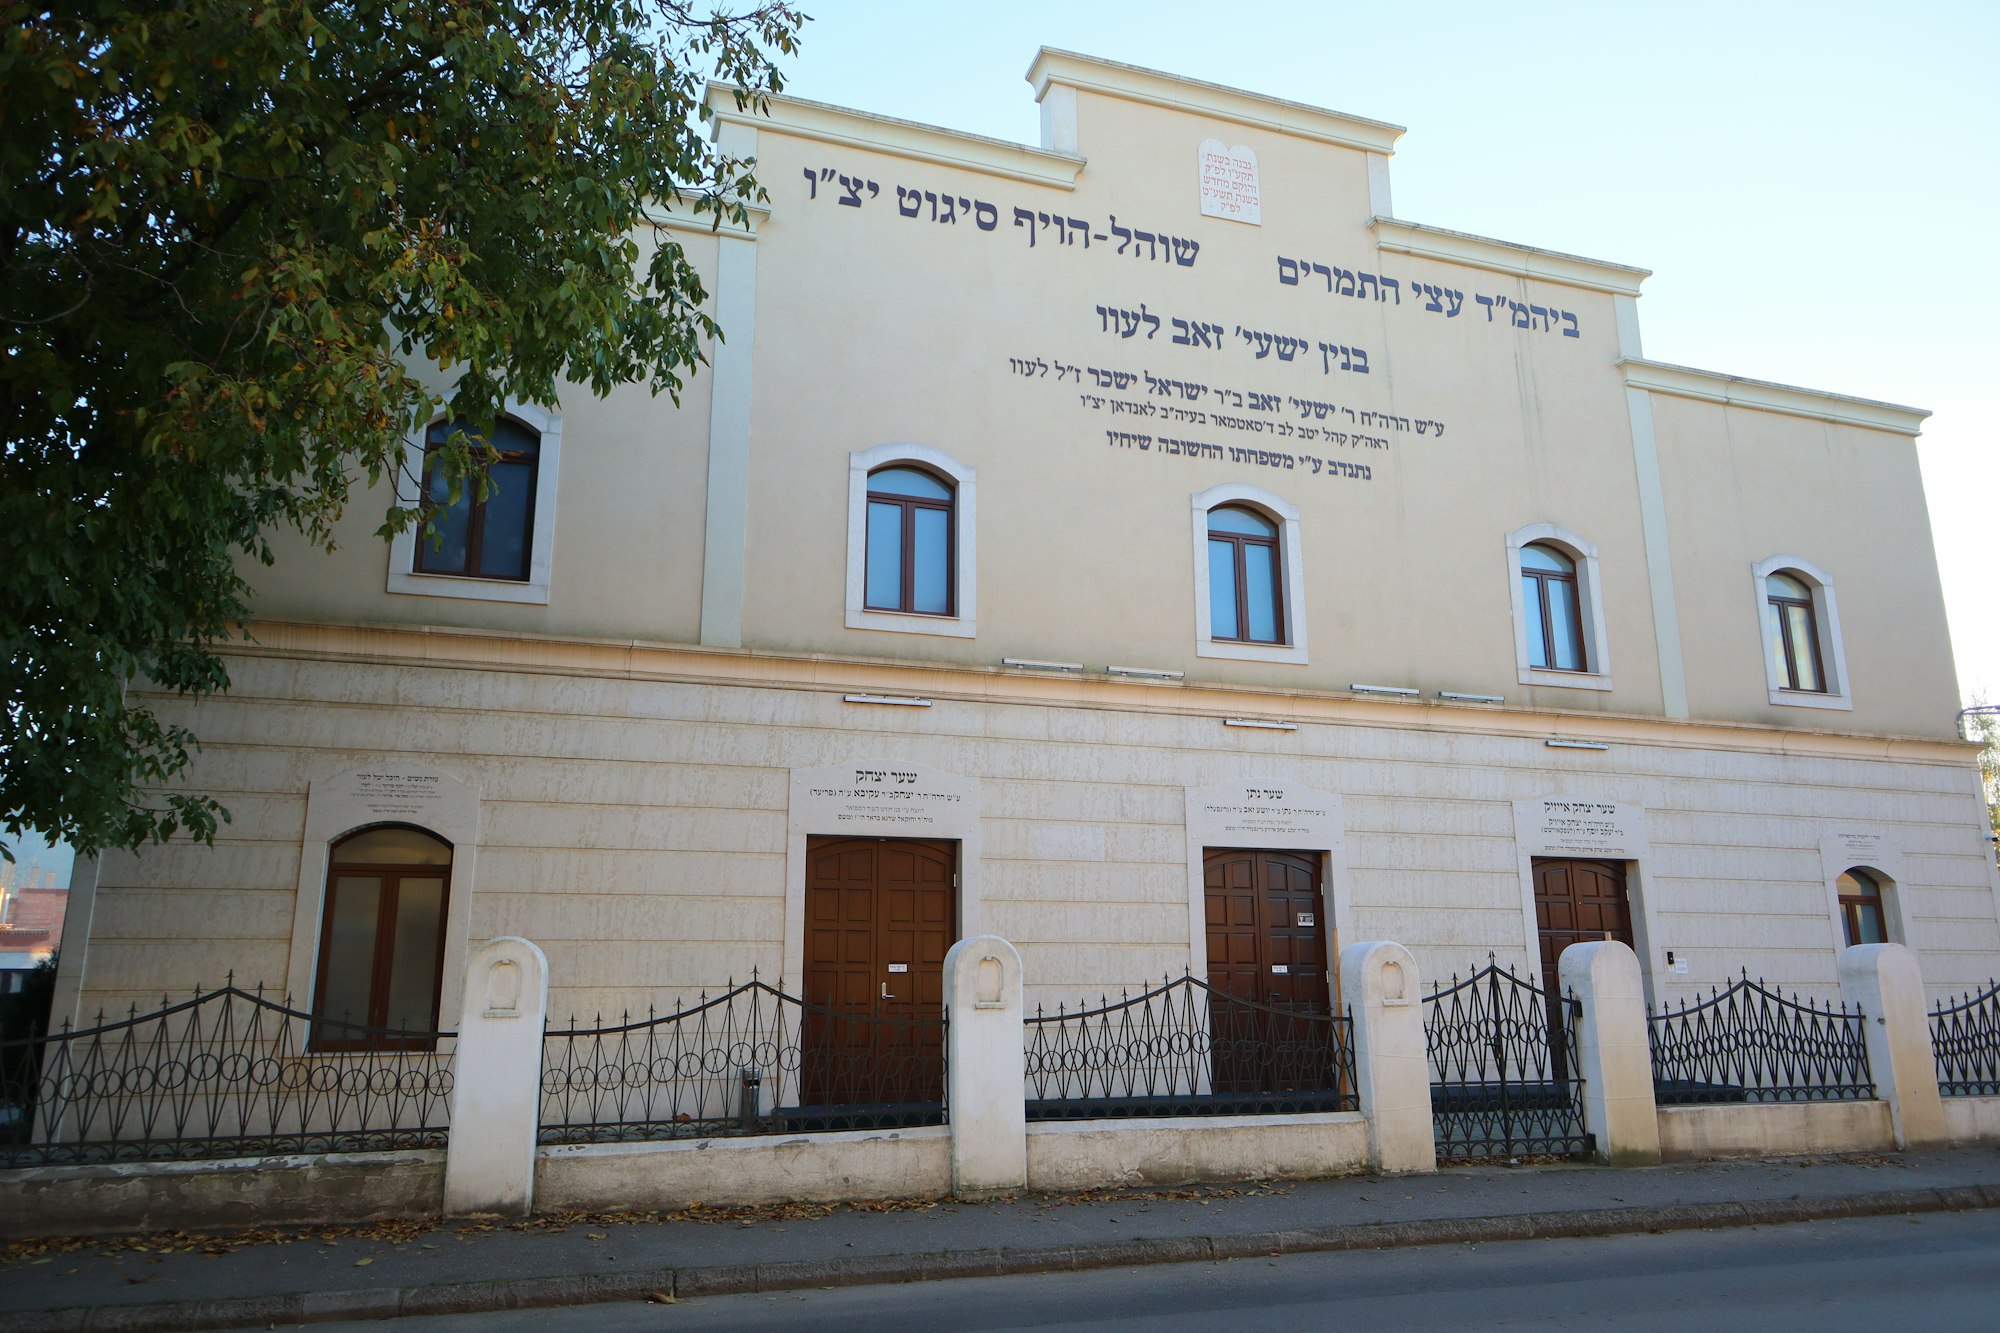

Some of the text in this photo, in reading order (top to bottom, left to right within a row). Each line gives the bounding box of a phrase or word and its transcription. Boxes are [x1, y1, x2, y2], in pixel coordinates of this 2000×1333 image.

[1205, 164, 1226, 175] לפ"ק
[1206, 153, 1252, 170] נבנה בשנת
[804, 167, 879, 208] יצ"ו
[1203, 175, 1257, 193] והוקם מחדש
[897, 185, 998, 231] סיגוט
[1235, 193, 1259, 206] בשנת
[1277, 255, 1579, 338] ביהמ"ד עצי התמרים
[1096, 303, 1369, 375] בנין ישעי' זאב לעוו
[1010, 357, 1048, 378] לעוו
[1054, 360, 1081, 383] ז"ל
[1087, 367, 1137, 390] ישכר
[1144, 370, 1208, 400] ישראל
[1081, 395, 1105, 409] יצ"ו
[1214, 389, 1243, 407] ב"ר
[1248, 392, 1281, 413] זאב
[1110, 400, 1156, 416] לאנדאן
[1288, 396, 1335, 419] ישעי'
[1278, 421, 1293, 436] לב
[1361, 411, 1409, 432] הרה"ח
[1415, 419, 1444, 437] ע"ש
[1298, 427, 1319, 439] יטב
[1322, 427, 1347, 446] קהל
[1107, 430, 1371, 480] נתנדב ע"י משפחתו החשובה שיחיו
[855, 769, 917, 785] שער יצחק
[854, 789, 880, 799] עקיבא
[1246, 788, 1284, 800] שער נתן
[1572, 803, 1594, 815] יצחק
[1596, 803, 1616, 814] שער
